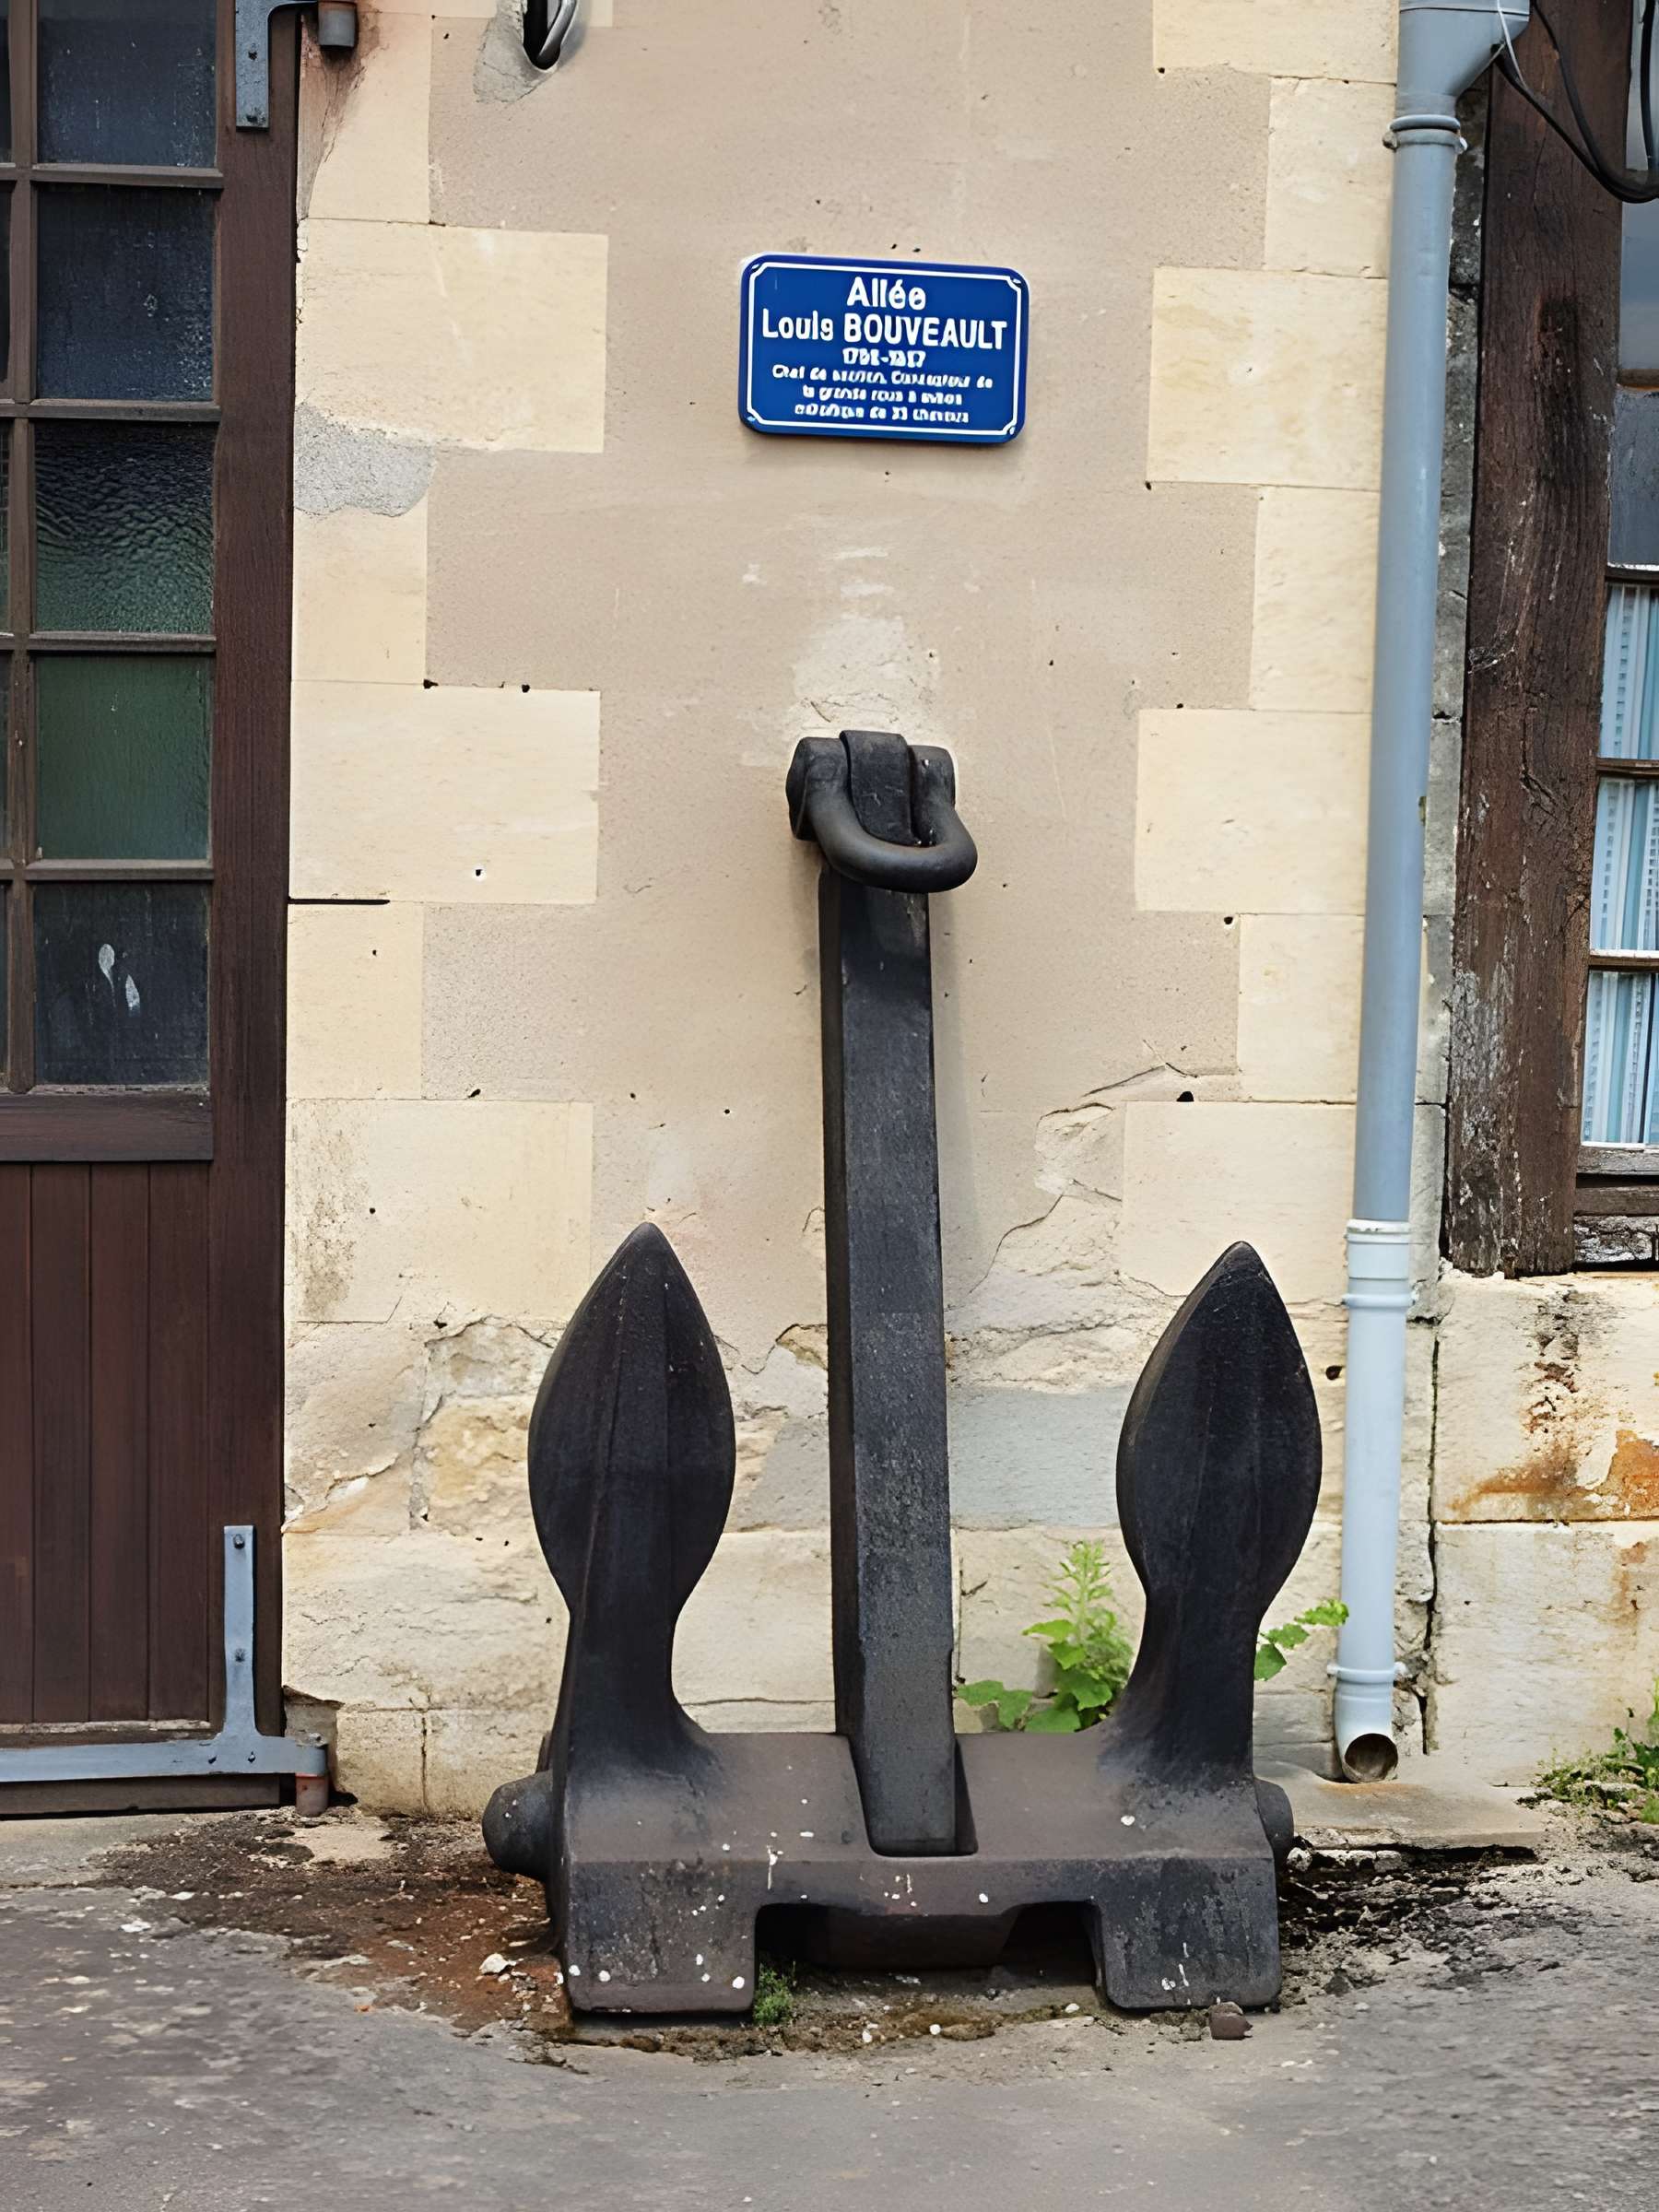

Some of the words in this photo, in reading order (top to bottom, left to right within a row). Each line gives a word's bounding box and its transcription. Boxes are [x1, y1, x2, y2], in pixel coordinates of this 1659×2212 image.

[847, 276, 926, 310] Allée
[762, 309, 834, 341] Louis
[843, 313, 1007, 349] BOUVEAULT
